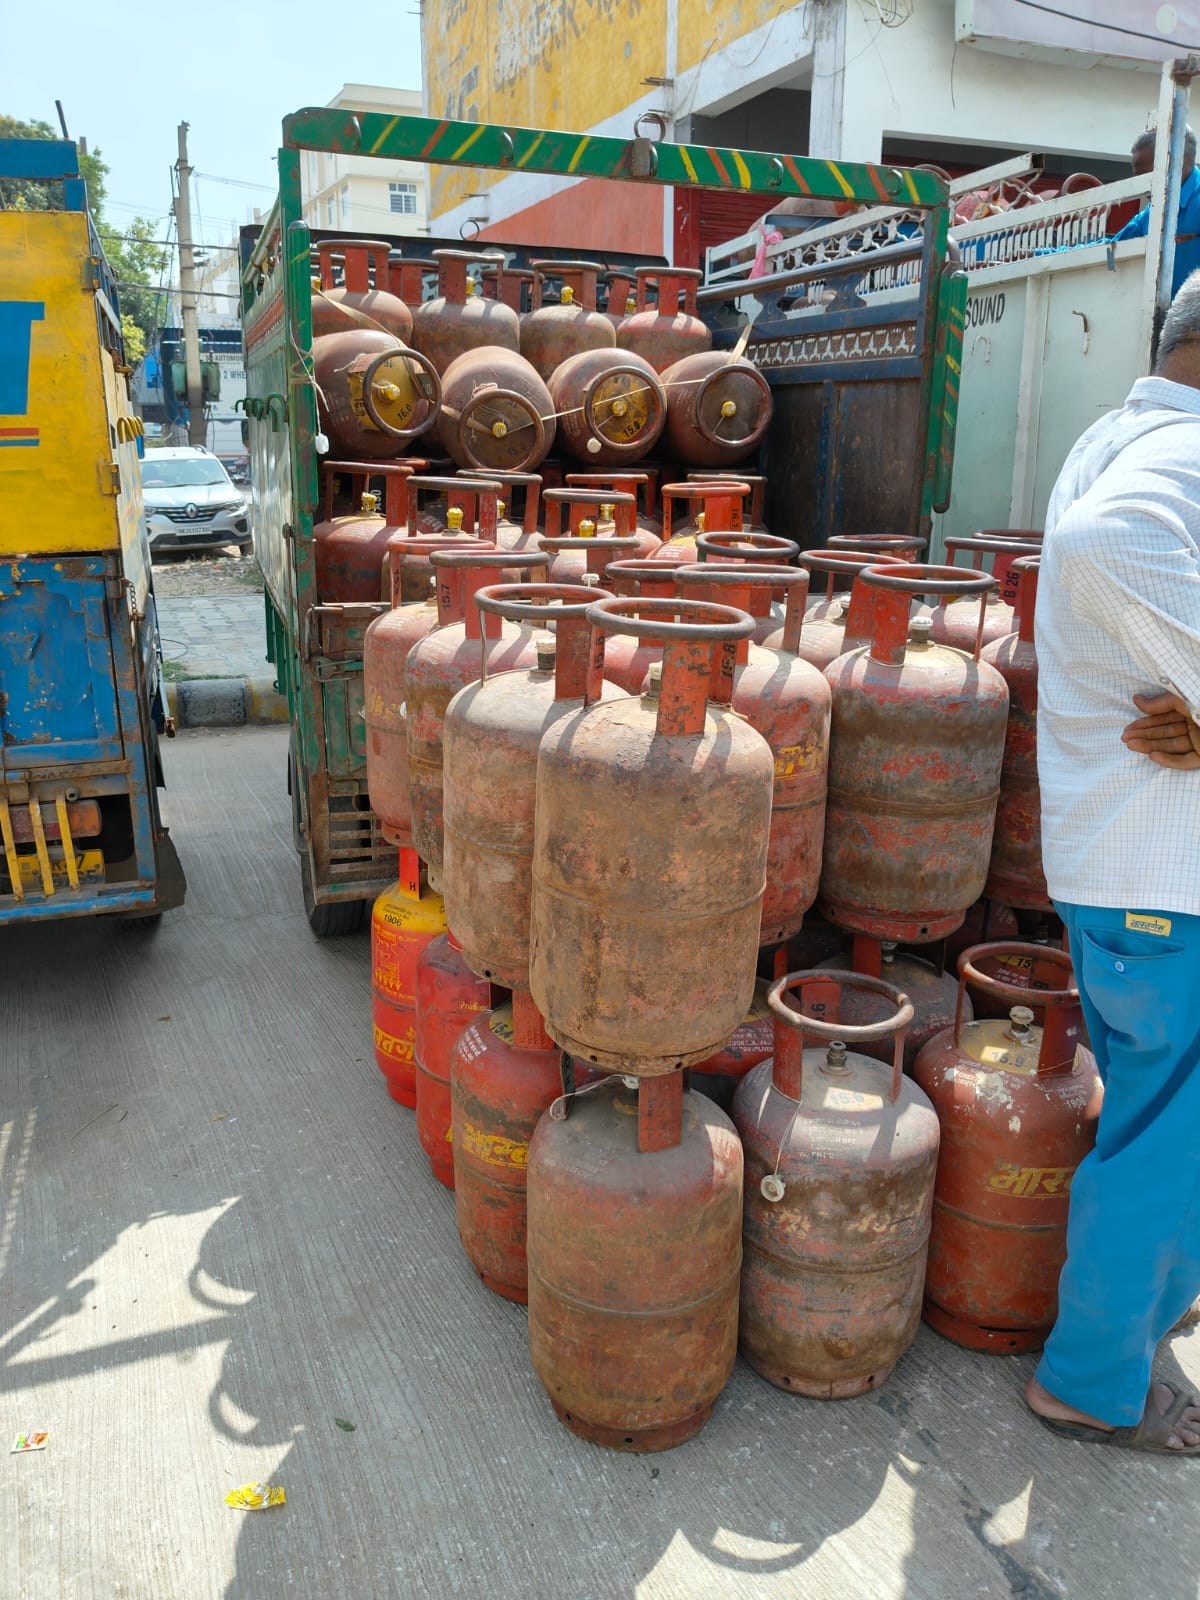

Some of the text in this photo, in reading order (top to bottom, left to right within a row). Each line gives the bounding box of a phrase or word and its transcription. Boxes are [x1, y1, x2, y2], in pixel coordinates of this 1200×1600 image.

[965, 293, 1005, 330] SOUND
[1003, 571, 1020, 598] B 26
[384, 914, 402, 926] 1906
[990, 1167, 1074, 1194] भार
